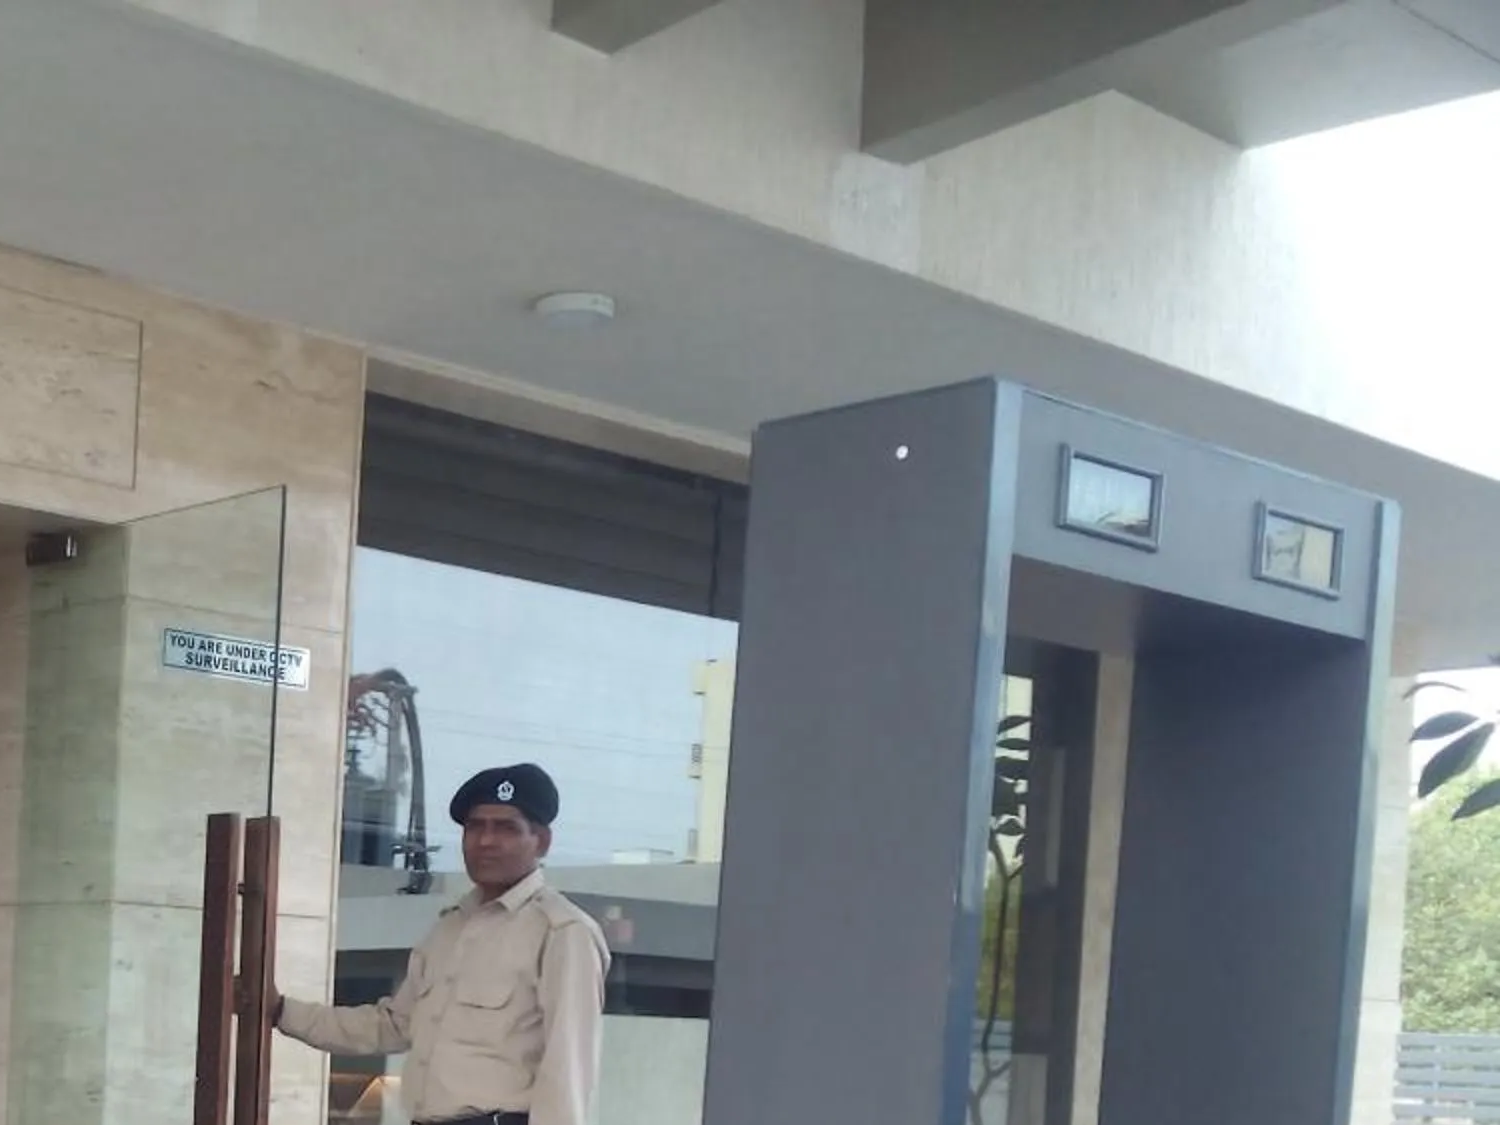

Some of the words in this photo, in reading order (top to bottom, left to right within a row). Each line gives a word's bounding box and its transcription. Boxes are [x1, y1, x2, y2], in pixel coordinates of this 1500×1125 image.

[169, 634, 196, 649] YOU
[199, 640, 225, 655] ARE
[226, 645, 269, 662] UNDER
[184, 651, 286, 681] SURVEILLANCE
